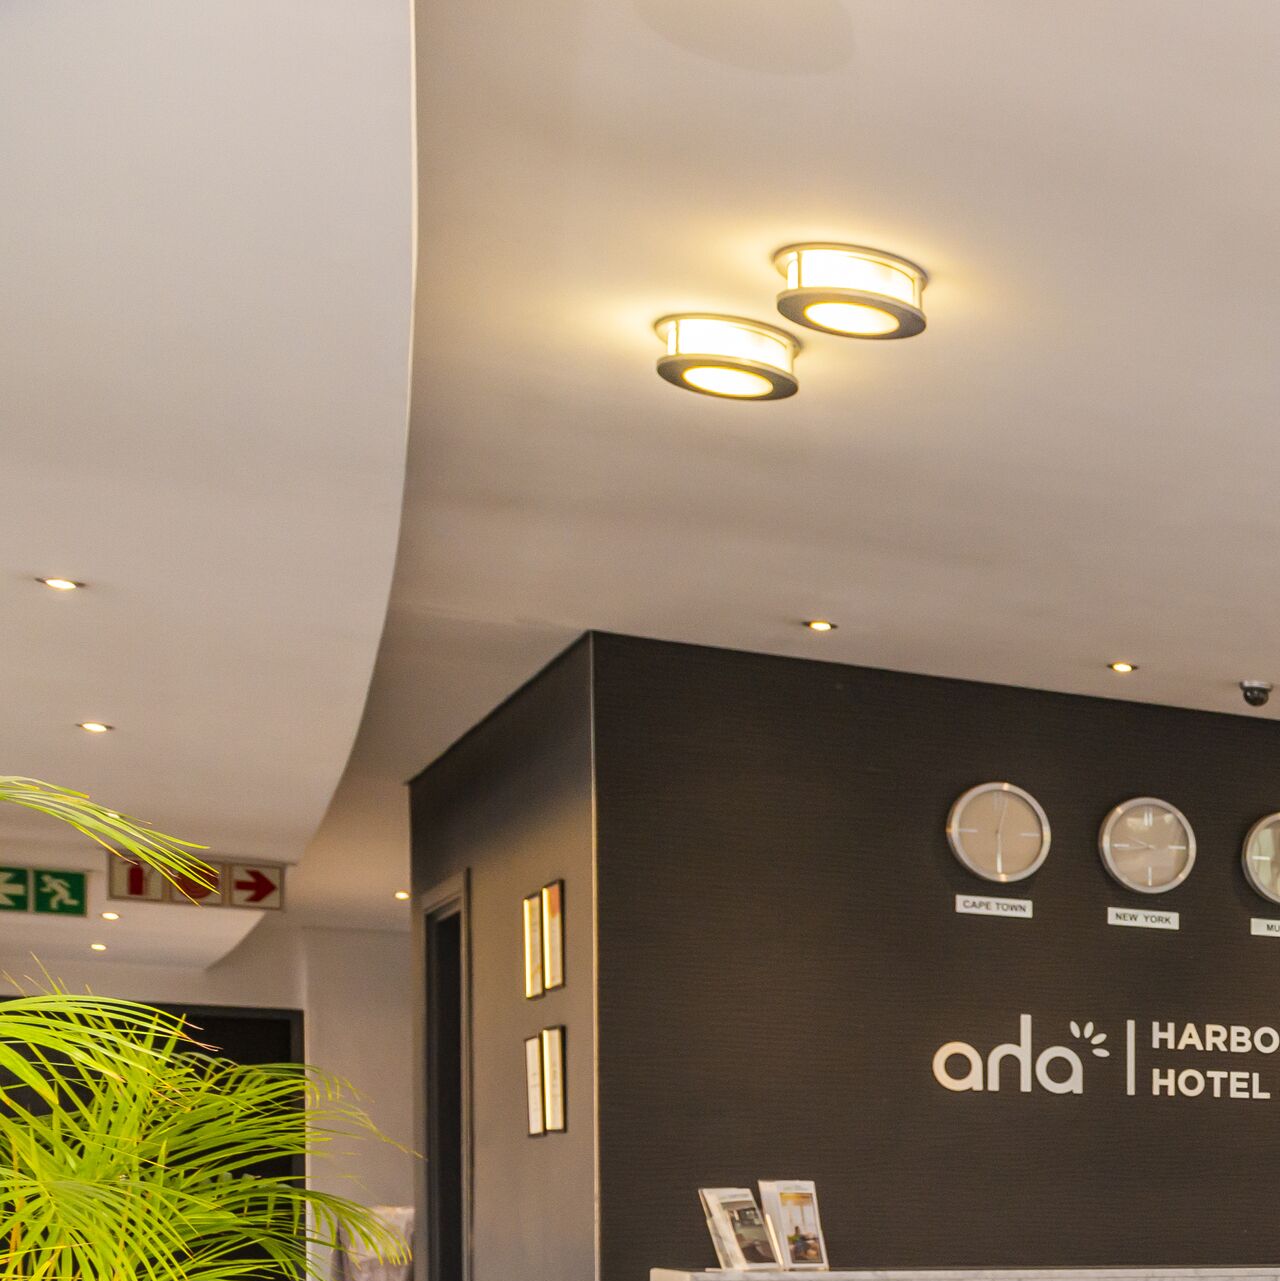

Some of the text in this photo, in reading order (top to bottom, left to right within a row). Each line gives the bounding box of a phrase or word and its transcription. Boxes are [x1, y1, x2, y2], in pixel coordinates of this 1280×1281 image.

[962, 899, 1027, 913] CAPE TOWN
[1115, 912, 1172, 925] NEW YORK
[1152, 1068, 1271, 1099] HOTEL
